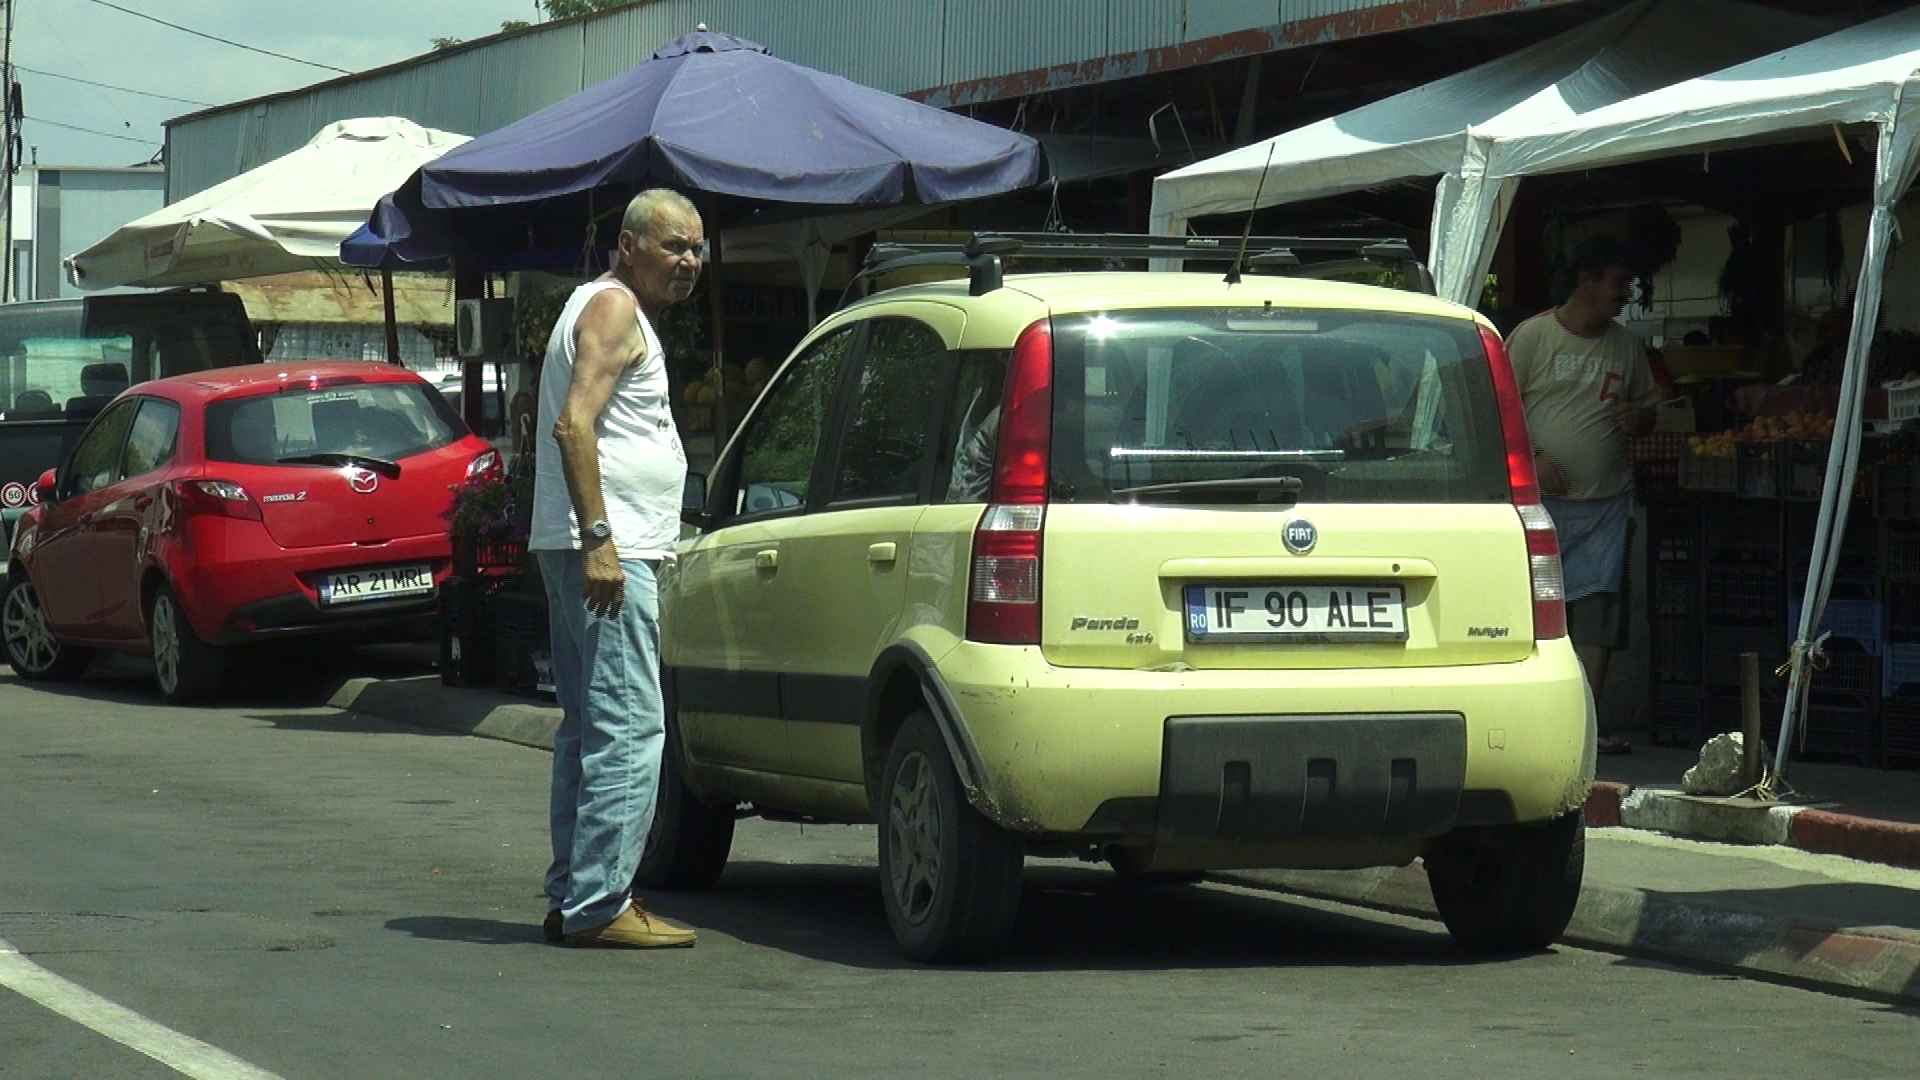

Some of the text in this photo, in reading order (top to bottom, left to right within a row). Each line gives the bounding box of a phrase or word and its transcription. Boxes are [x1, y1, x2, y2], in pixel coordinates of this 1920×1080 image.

[8, 490, 21, 500] 50
[296, 491, 307, 501] 2
[1289, 528, 1312, 541] FIAT
[333, 576, 361, 596] AR
[369, 571, 388, 591] 21
[392, 568, 430, 589] MRL
[1191, 591, 1393, 628] RO IF 90 ALE
[1070, 616, 1139, 631] Panda
[1125, 633, 1154, 645] 4x4
